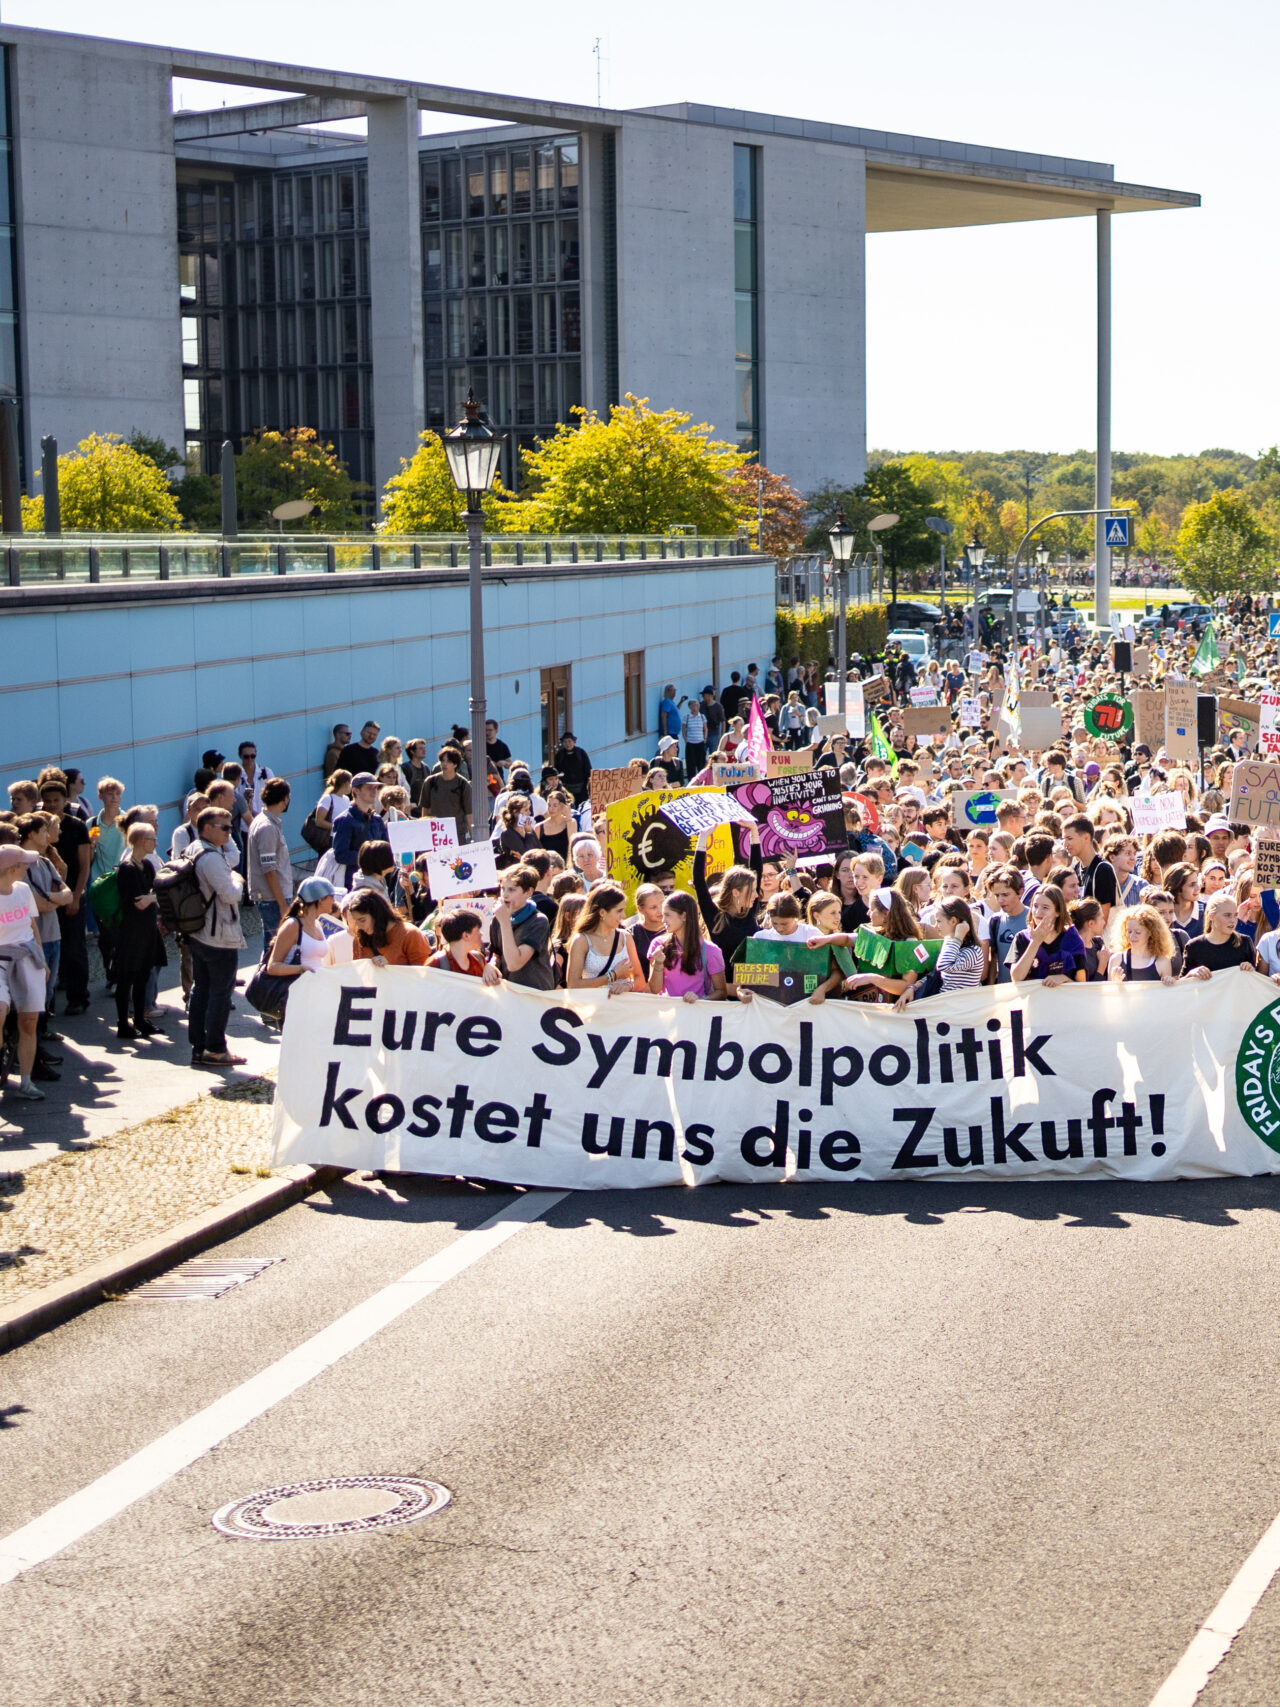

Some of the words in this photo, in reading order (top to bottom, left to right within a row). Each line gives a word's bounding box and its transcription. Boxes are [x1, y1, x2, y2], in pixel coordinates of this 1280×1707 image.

[771, 755, 791, 765] RUN
[777, 766, 811, 775] FOREST
[767, 777, 790, 787] WHEN
[791, 774, 806, 783] YOU
[808, 772, 823, 780] TRY
[826, 769, 836, 777] TO
[771, 784, 802, 794] JUSTIFY
[804, 780, 823, 789] YOUR
[430, 821, 444, 832] Die
[432, 833, 453, 846] Erde
[1259, 842, 1280, 852] EURE
[1257, 874, 1272, 884] DIE
[735, 964, 762, 973] TREES
[764, 963, 779, 973] FOR
[735, 973, 769, 984] FUTURE
[333, 985, 502, 1058] Eure
[531, 1007, 1056, 1105] Symbolpolitik
[1242, 1024, 1280, 1137] FRIDAYS
[319, 1061, 552, 1148] kostet
[580, 1109, 715, 1167] uns
[740, 1100, 862, 1172] die
[891, 1088, 1168, 1170] Zukuft!
